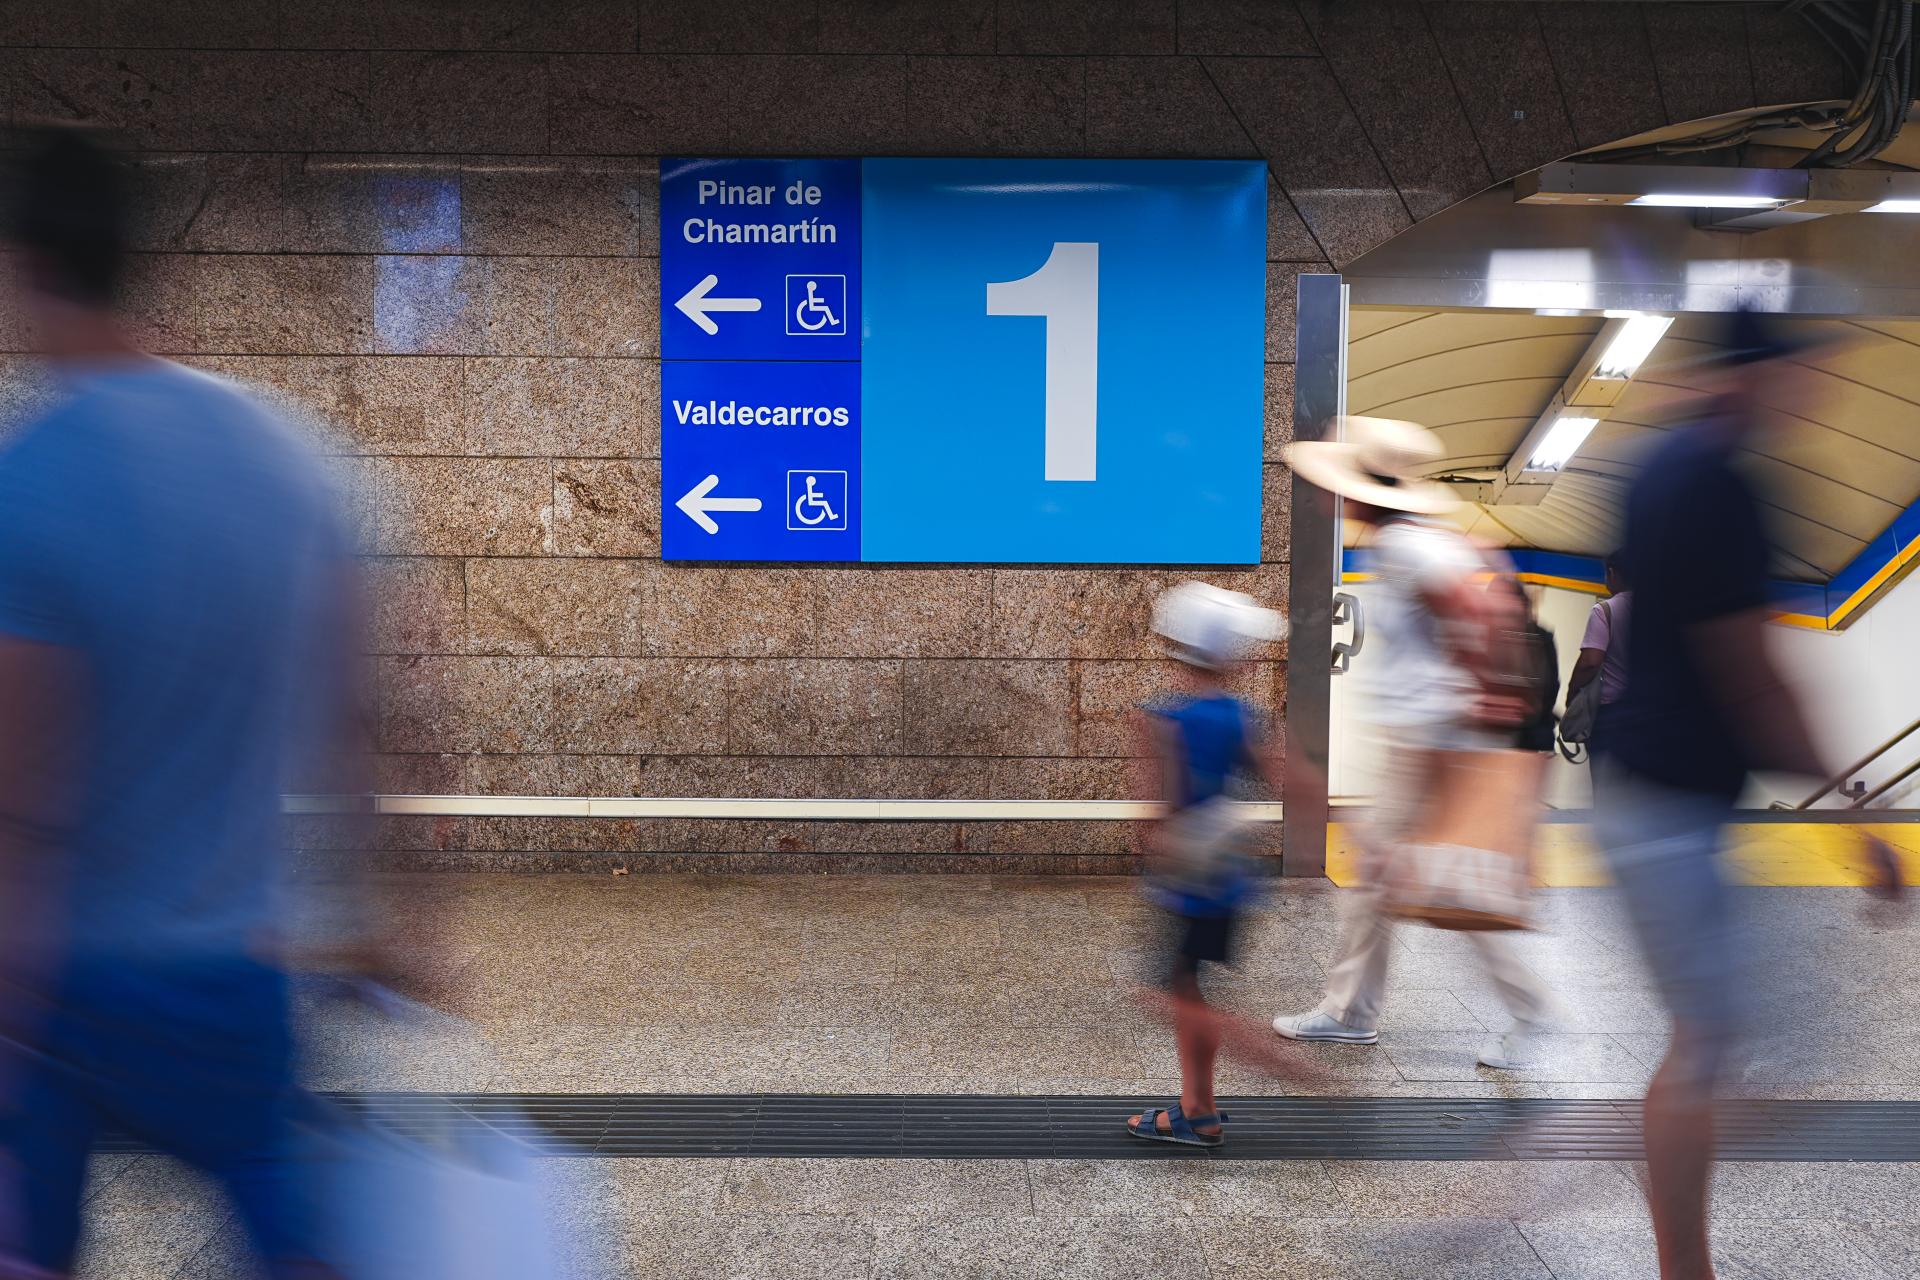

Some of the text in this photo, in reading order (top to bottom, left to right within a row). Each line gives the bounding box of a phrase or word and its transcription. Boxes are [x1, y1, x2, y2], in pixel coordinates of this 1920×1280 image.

[699, 181, 821, 204] Pinar de
[684, 217, 836, 244] Chamartín
[986, 242, 1099, 482] 1
[673, 400, 849, 427] Valdecarros
